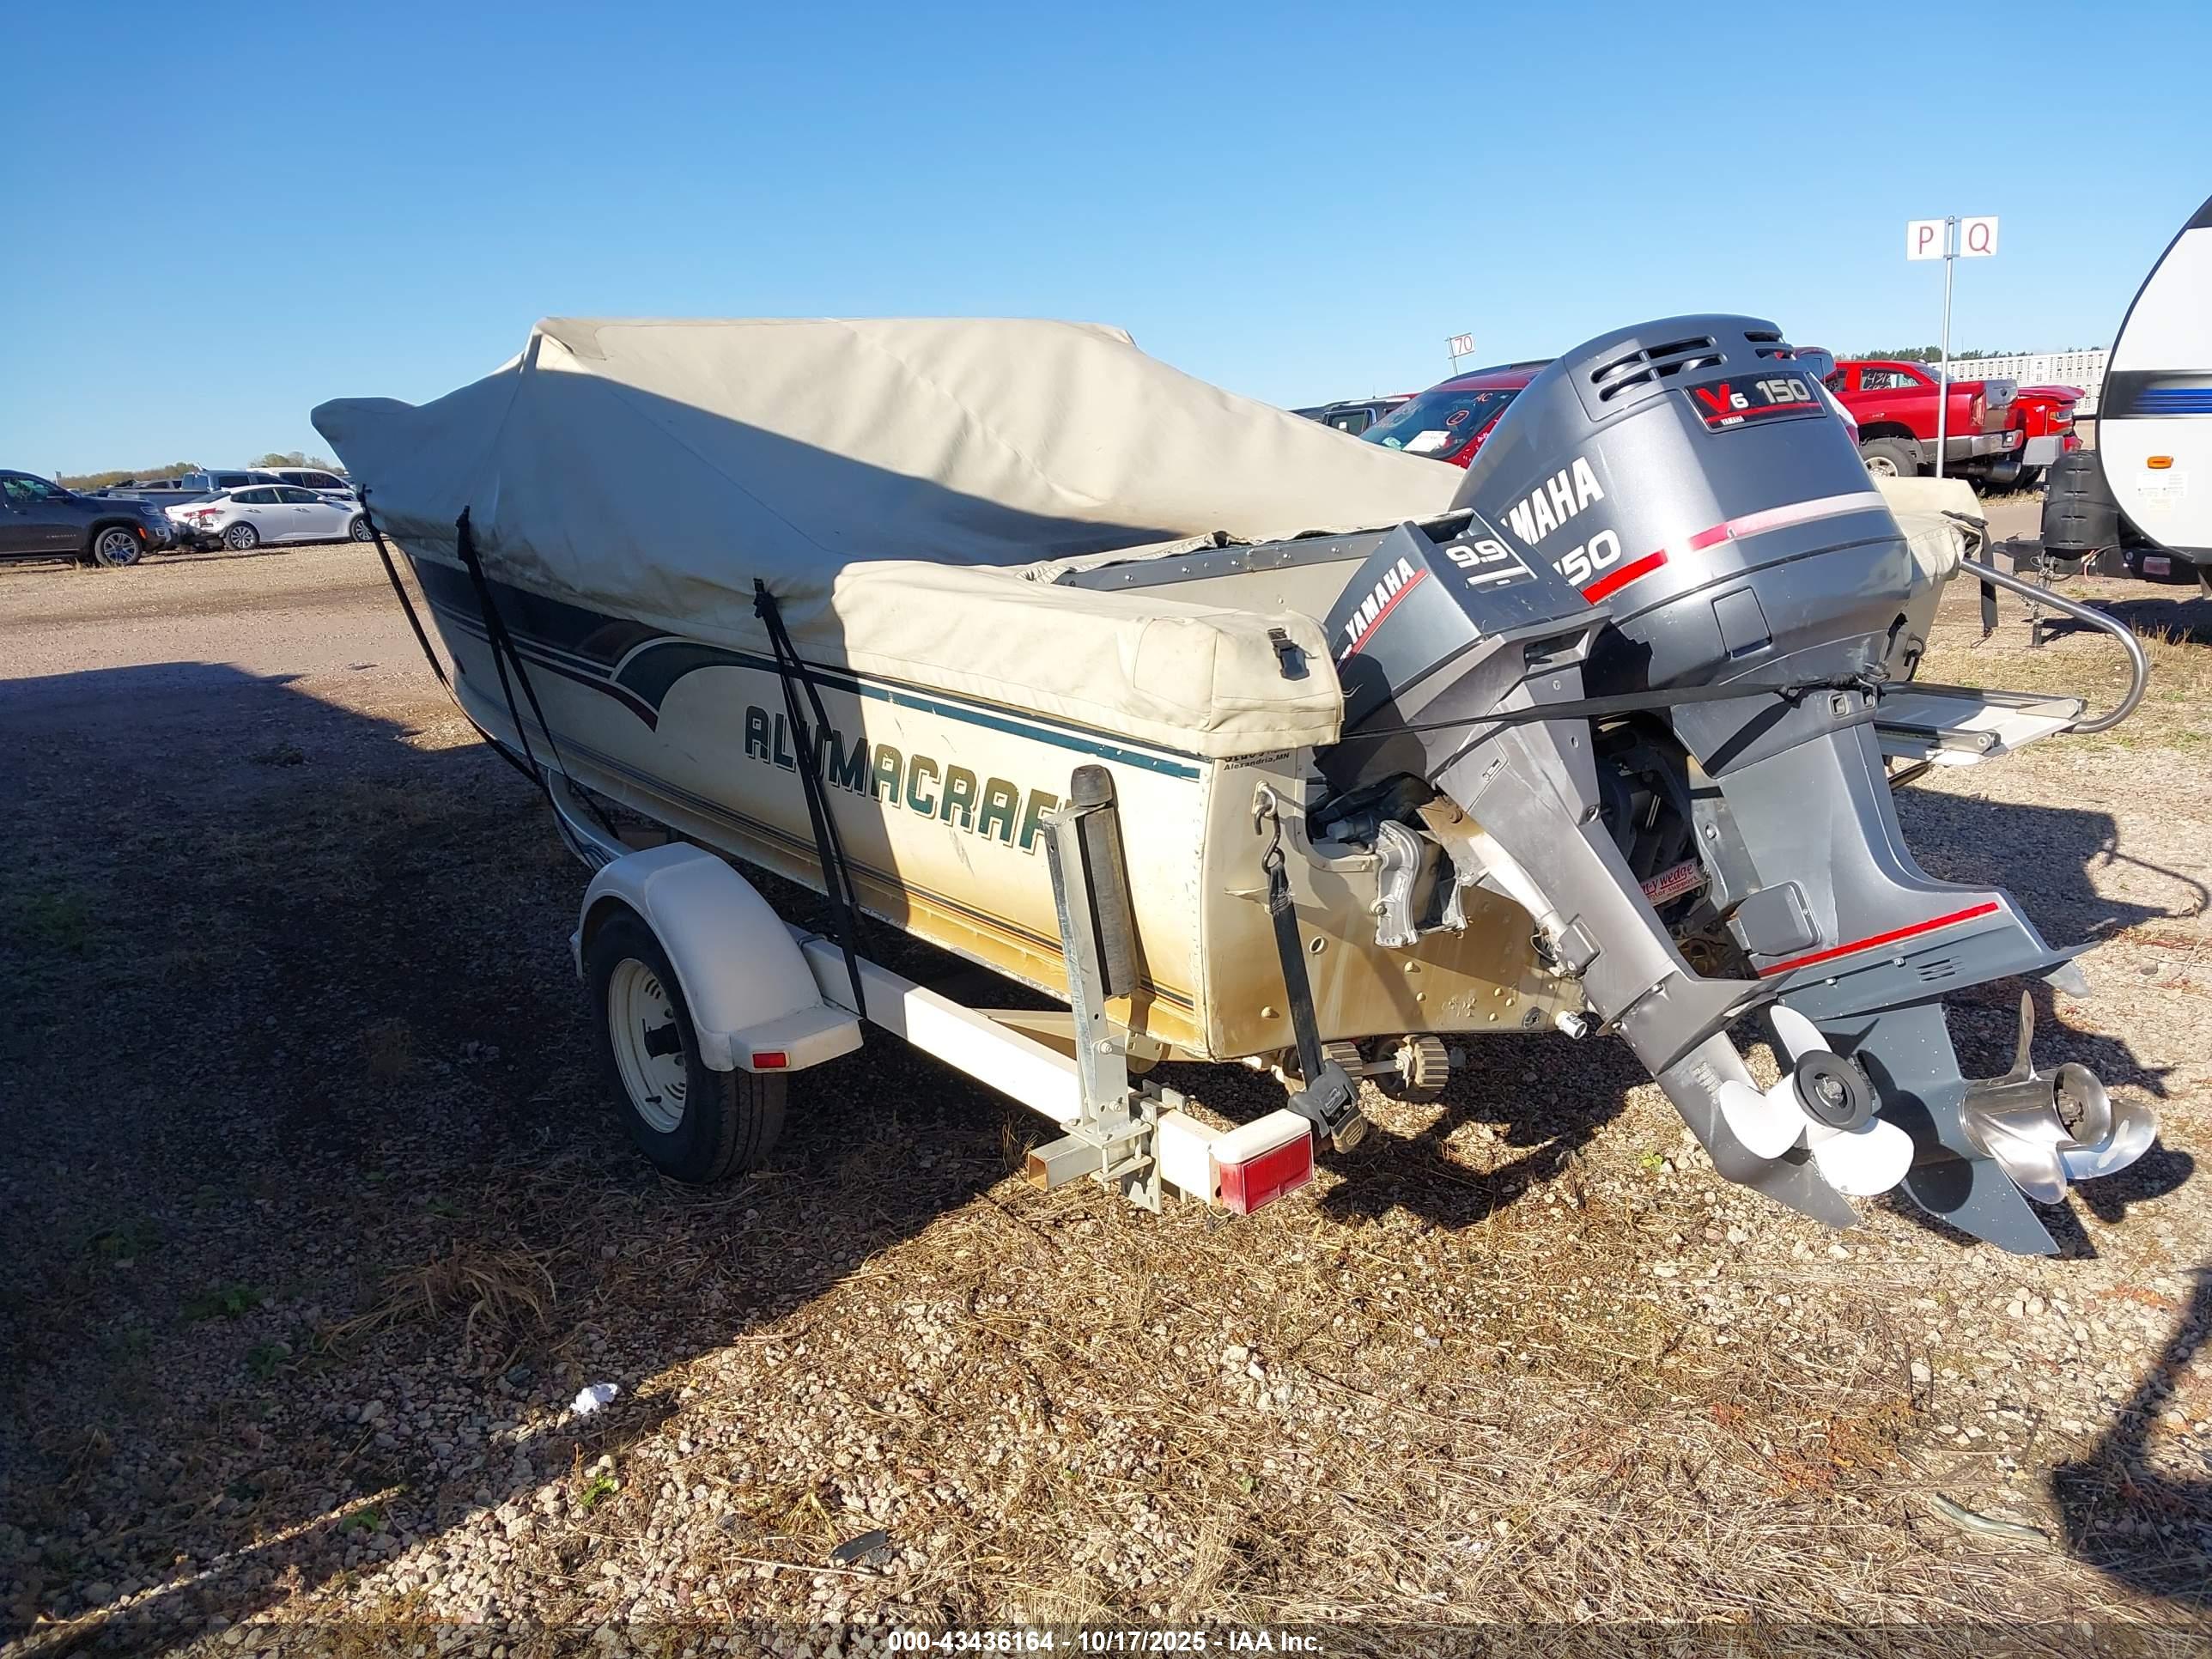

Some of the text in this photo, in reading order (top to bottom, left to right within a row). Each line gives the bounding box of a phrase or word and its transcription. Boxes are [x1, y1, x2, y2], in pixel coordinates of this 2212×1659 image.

[1918, 226, 1934, 254] P
[1968, 222, 1991, 254] Q
[1455, 336, 1473, 354] 70
[1755, 379, 1812, 404] 150
[1500, 456, 1605, 545] MAHA
[1446, 539, 1508, 568] 9.9
[1345, 557, 1416, 644] YAMAHA
[744, 705, 1072, 855] ALMACRAF
